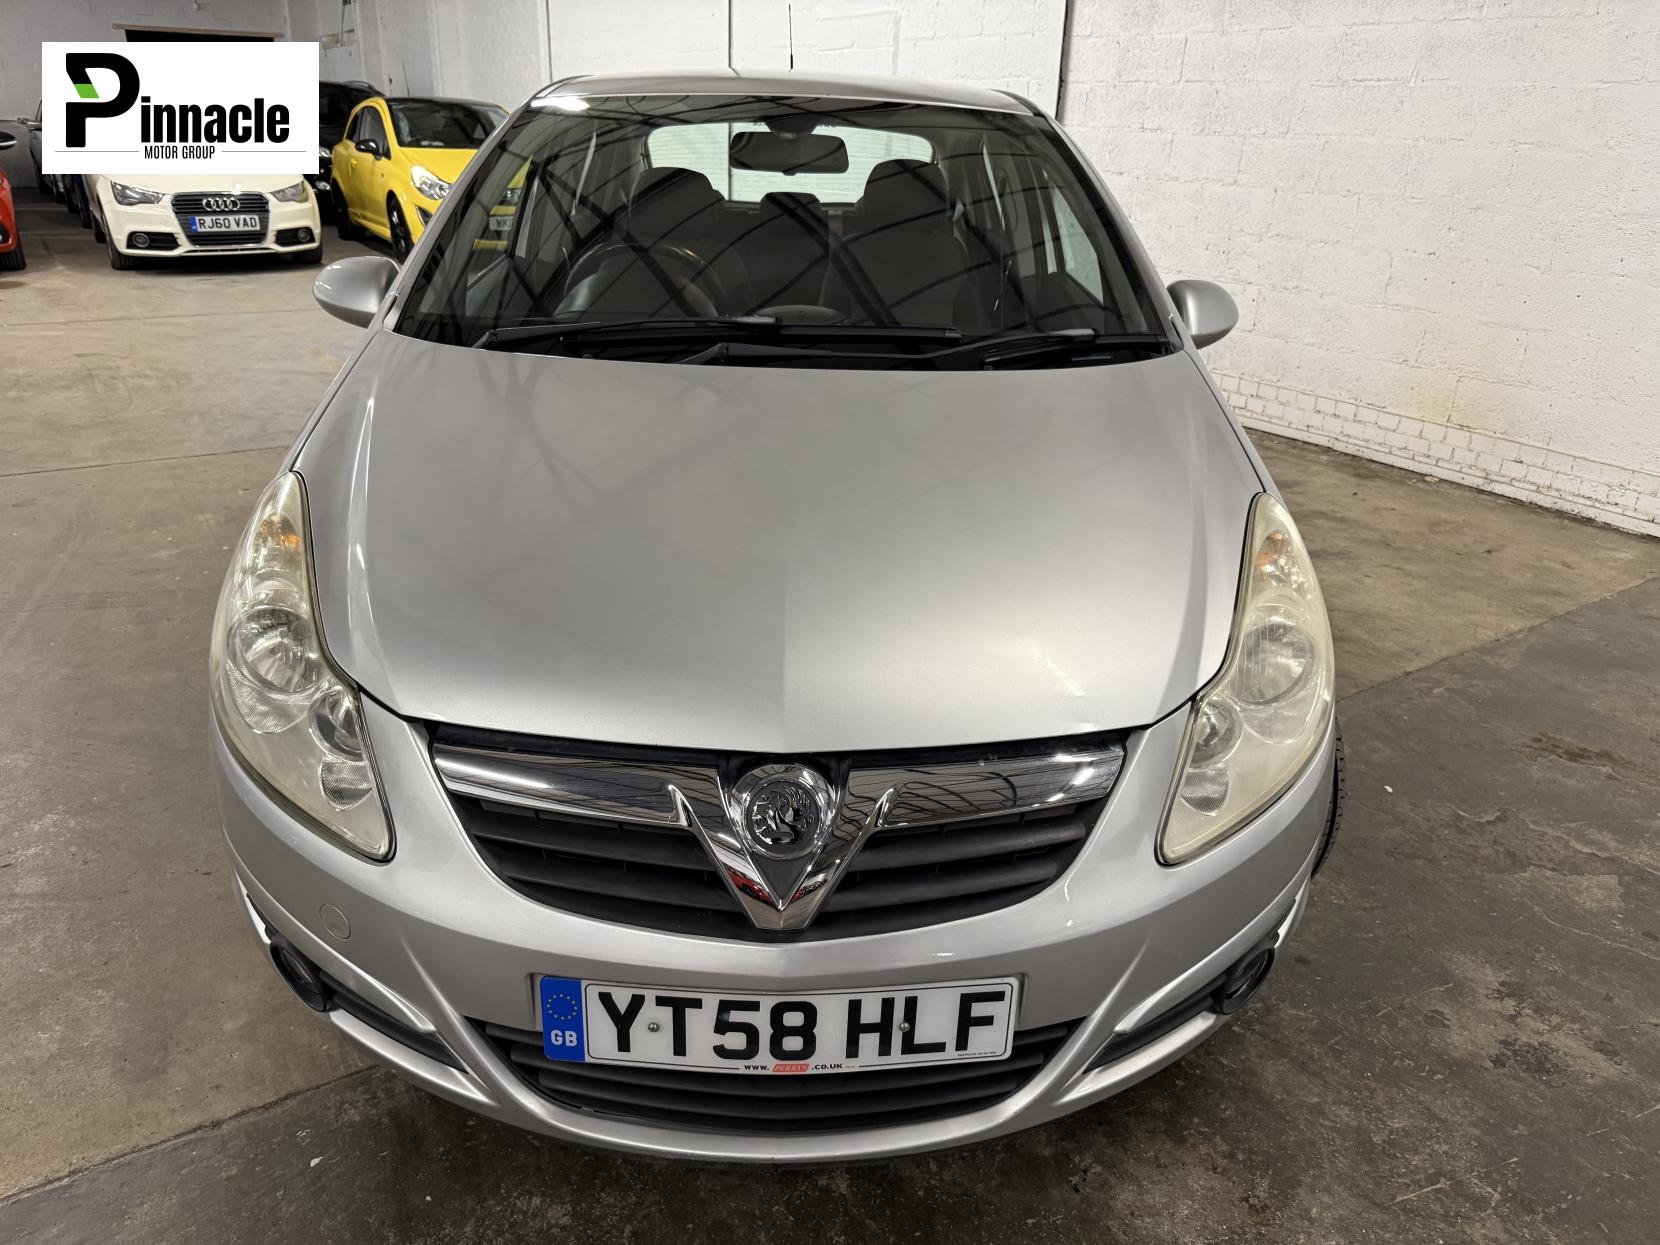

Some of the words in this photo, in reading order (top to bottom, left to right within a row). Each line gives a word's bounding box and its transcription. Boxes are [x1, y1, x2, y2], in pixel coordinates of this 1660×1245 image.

[198, 217, 231, 230] RJ60
[234, 216, 258, 229] VAD
[597, 991, 818, 1061] YT58
[845, 990, 1006, 1059] HLF
[550, 1029, 578, 1047] GB
